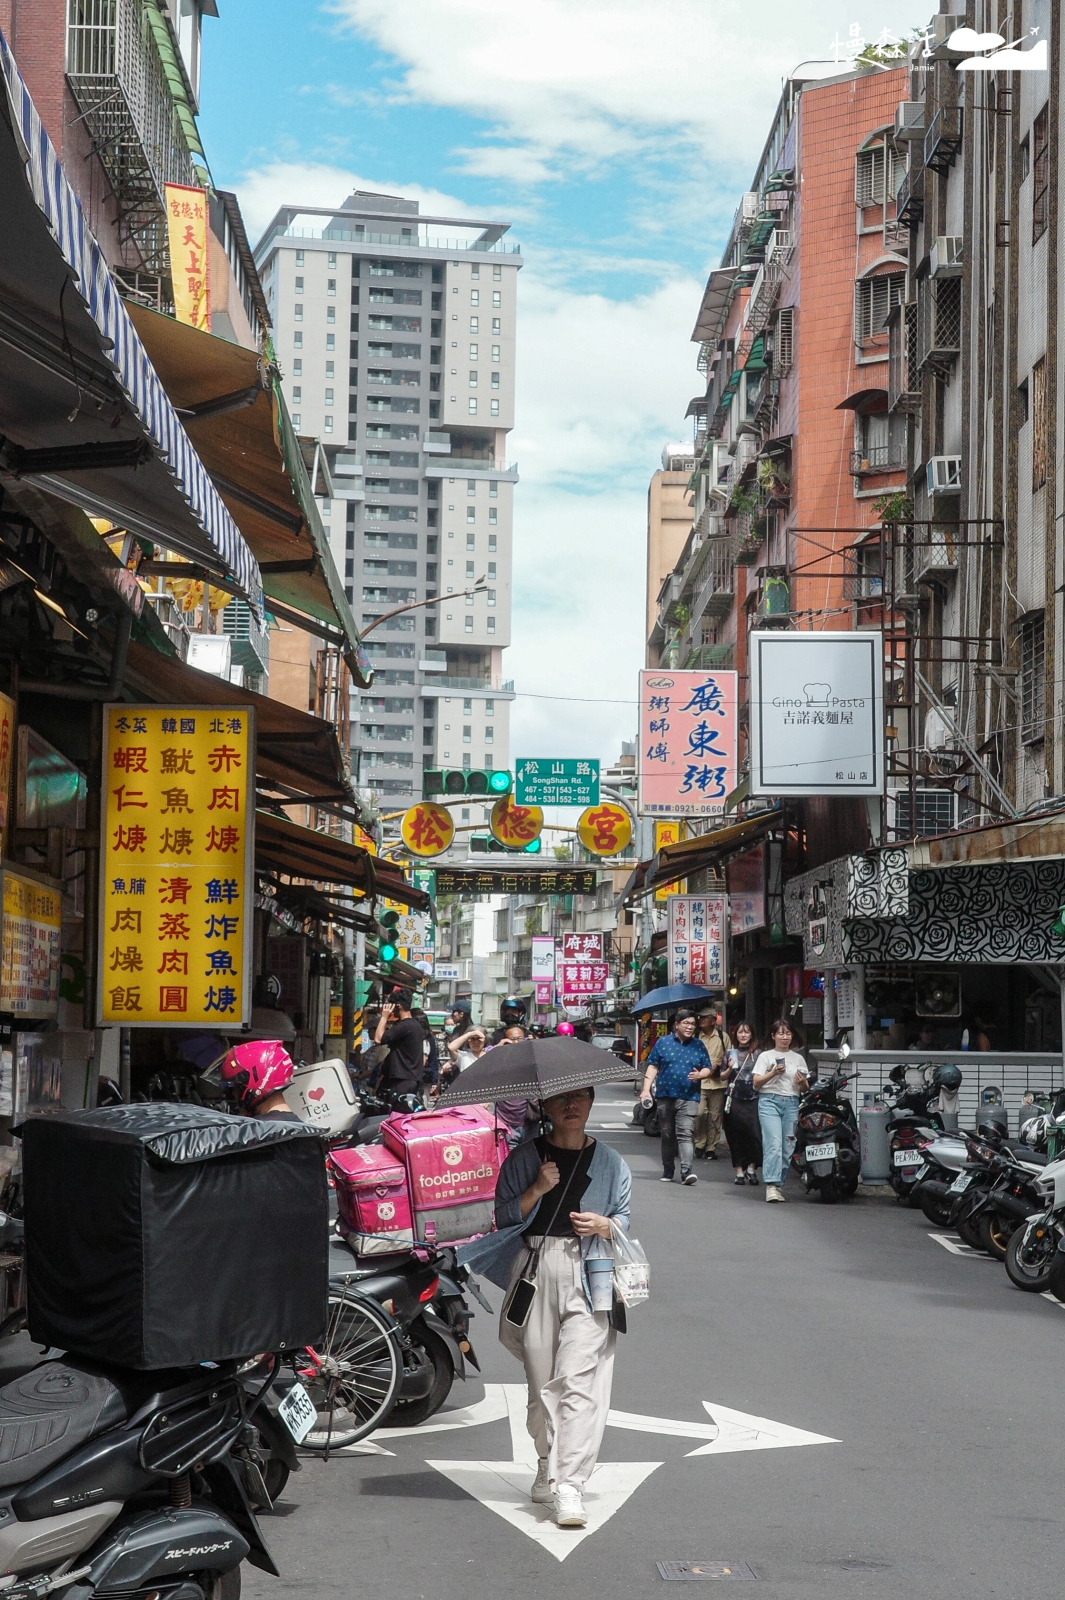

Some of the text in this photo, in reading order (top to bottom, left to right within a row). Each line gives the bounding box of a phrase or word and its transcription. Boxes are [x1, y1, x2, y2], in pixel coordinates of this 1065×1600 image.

[772, 696, 865, 708] Gino Pasta
[114, 717, 148, 734] 冬菜
[161, 717, 196, 735] 韓國
[208, 717, 243, 735] 北港
[782, 710, 854, 725] 吉諾義麵屋
[646, 695, 671, 763] 粥師傅
[678, 677, 728, 799] 廣東粥
[524, 761, 591, 775] 松山路
[835, 771, 868, 780] 松山店
[532, 776, 569, 785] SongShan
[112, 746, 149, 853] 蝦仁焿
[159, 747, 196, 856] 魷魚焿
[204, 744, 242, 855] 赤肉焿
[111, 877, 147, 896] 魚脯
[156, 877, 192, 1013] 清蒸肉圓
[203, 877, 240, 1014] 鮮炸魚焿
[565, 934, 601, 951] 府城
[109, 907, 144, 1013] 肉燥飯
[674, 946, 688, 984] 四神湯
[691, 945, 706, 984] 蚵仔煎
[709, 945, 722, 984] 當歸鴨
[301, 1102, 331, 1119] Tea
[418, 1164, 494, 1188] foodpanda
[164, 1540, 234, 1560] スピードハンターズ
